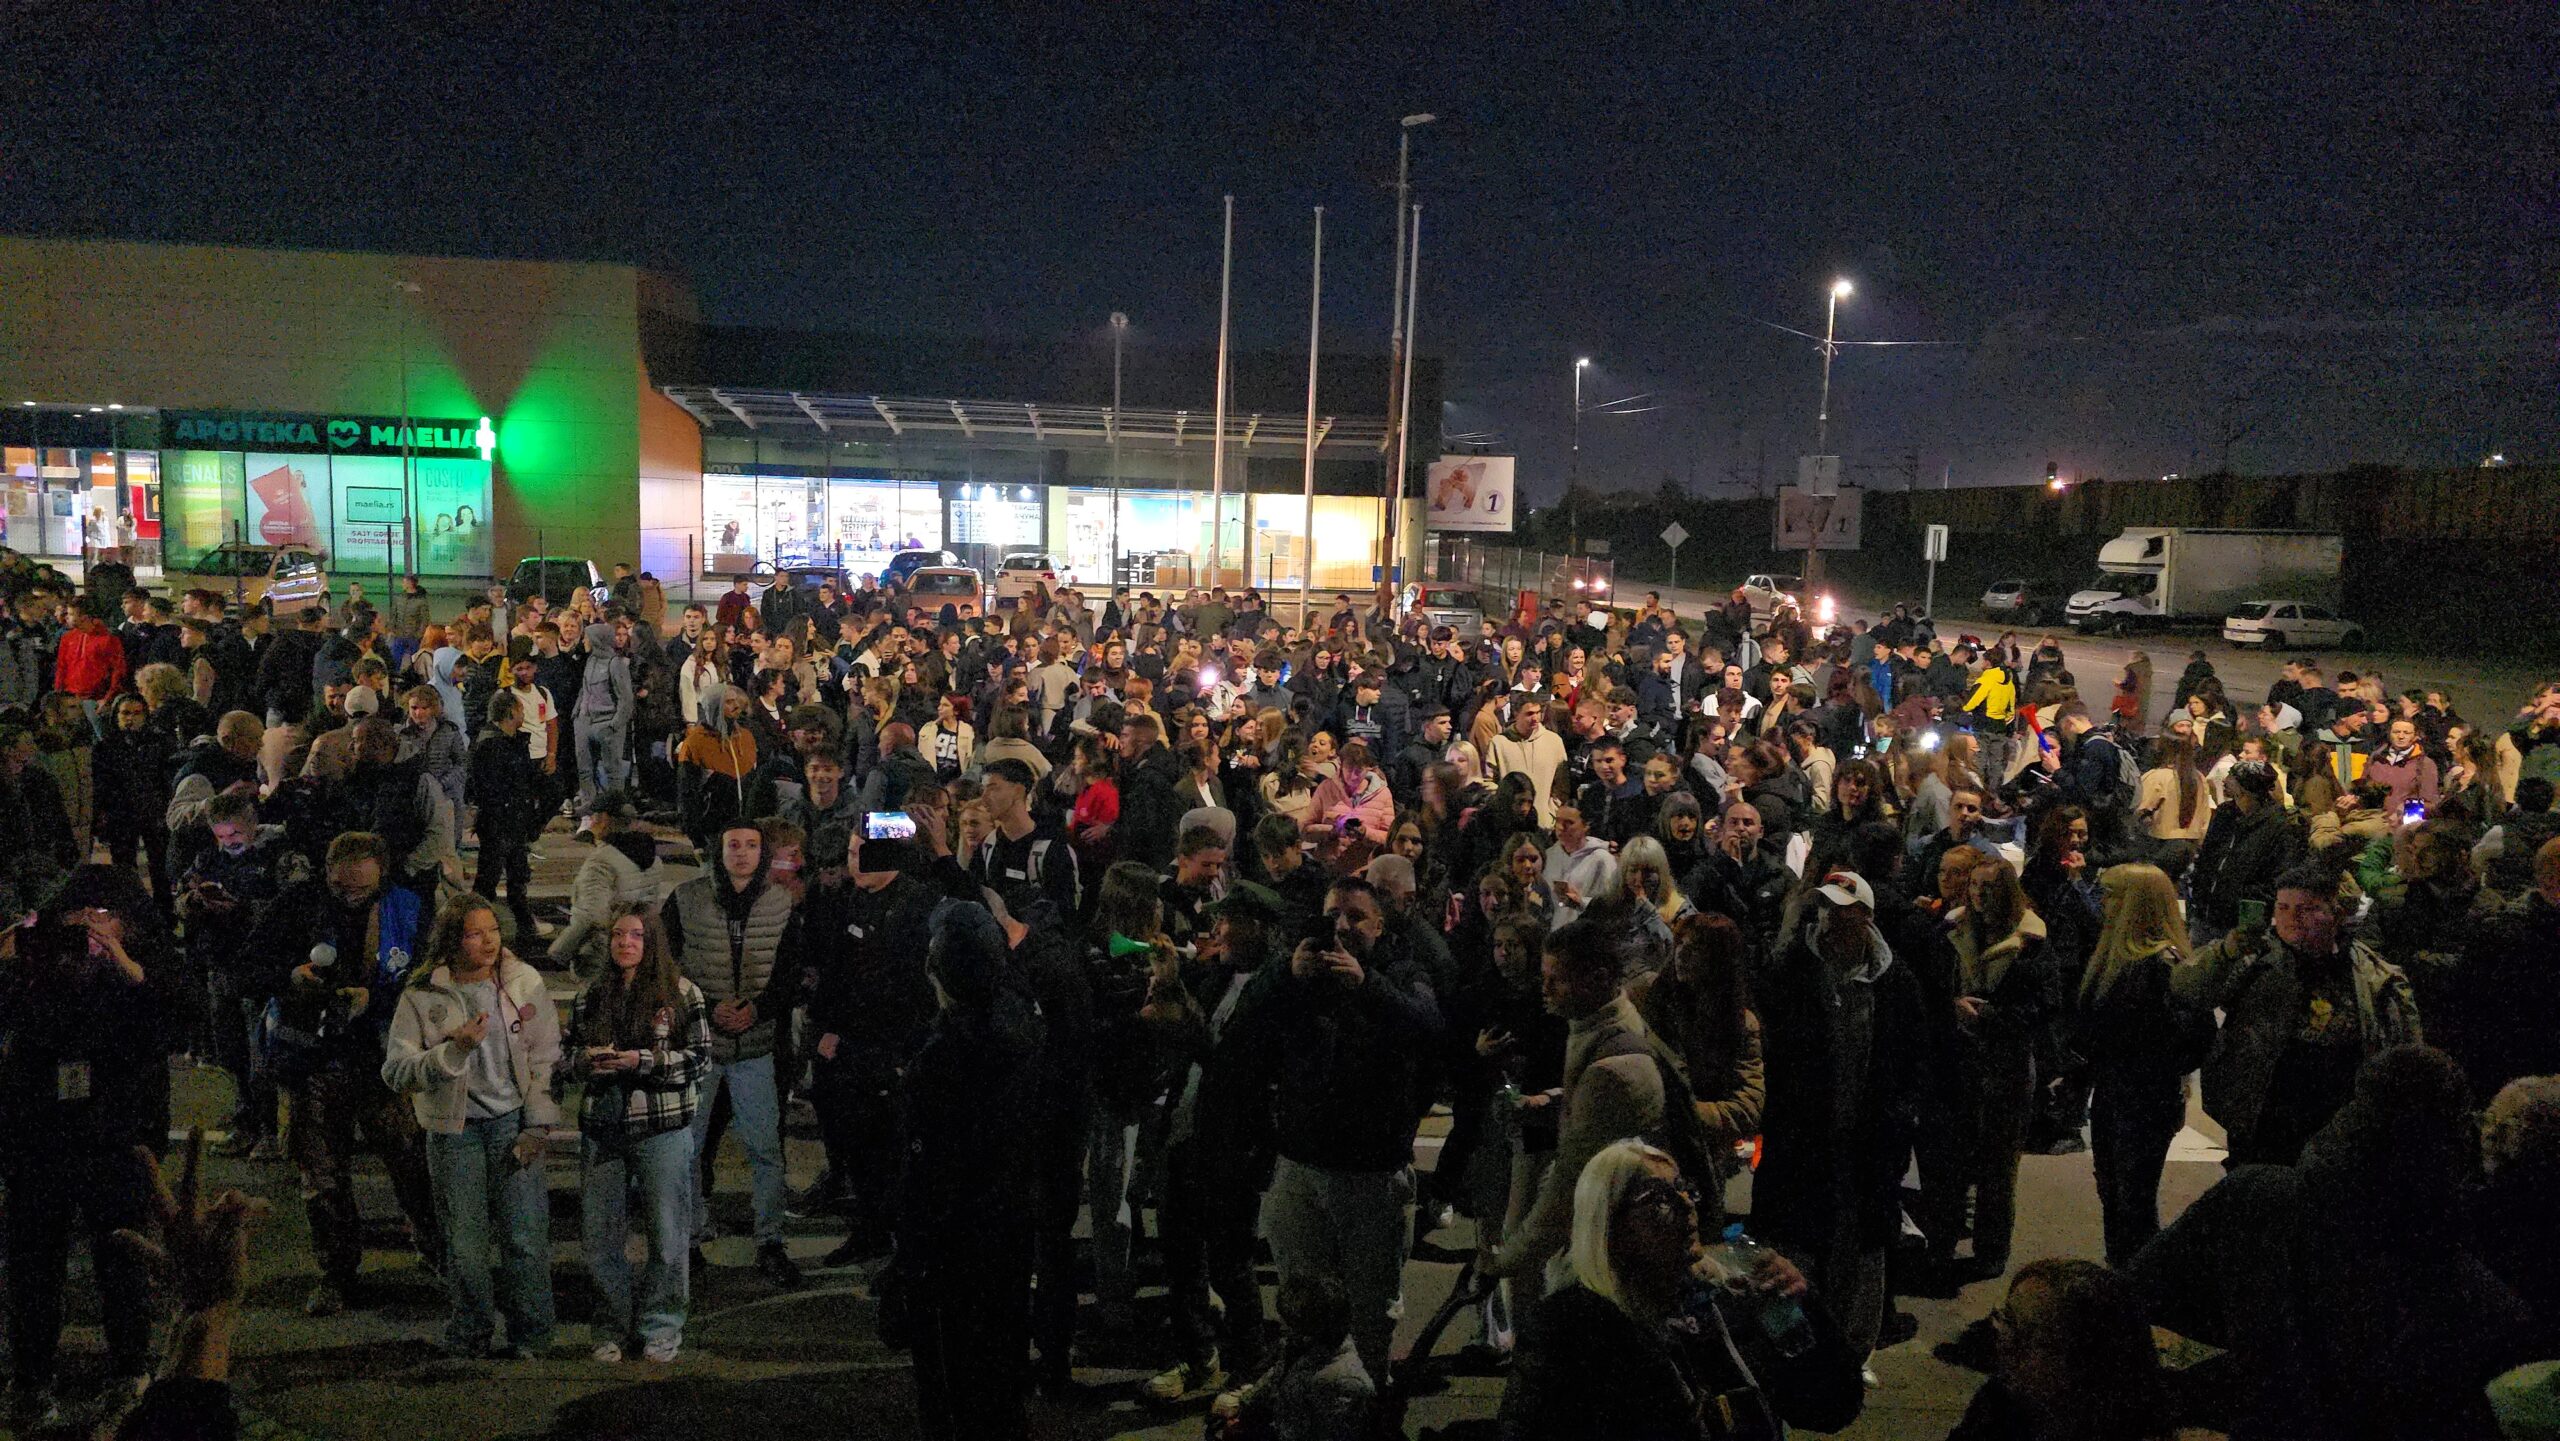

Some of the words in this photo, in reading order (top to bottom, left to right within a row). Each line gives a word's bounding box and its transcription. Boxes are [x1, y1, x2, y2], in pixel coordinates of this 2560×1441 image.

[175, 420, 318, 444] APOTEKA
[370, 425, 477, 449] MAELIA
[354, 500, 395, 510] maelia.rs
[1487, 493, 1498, 512] 1
